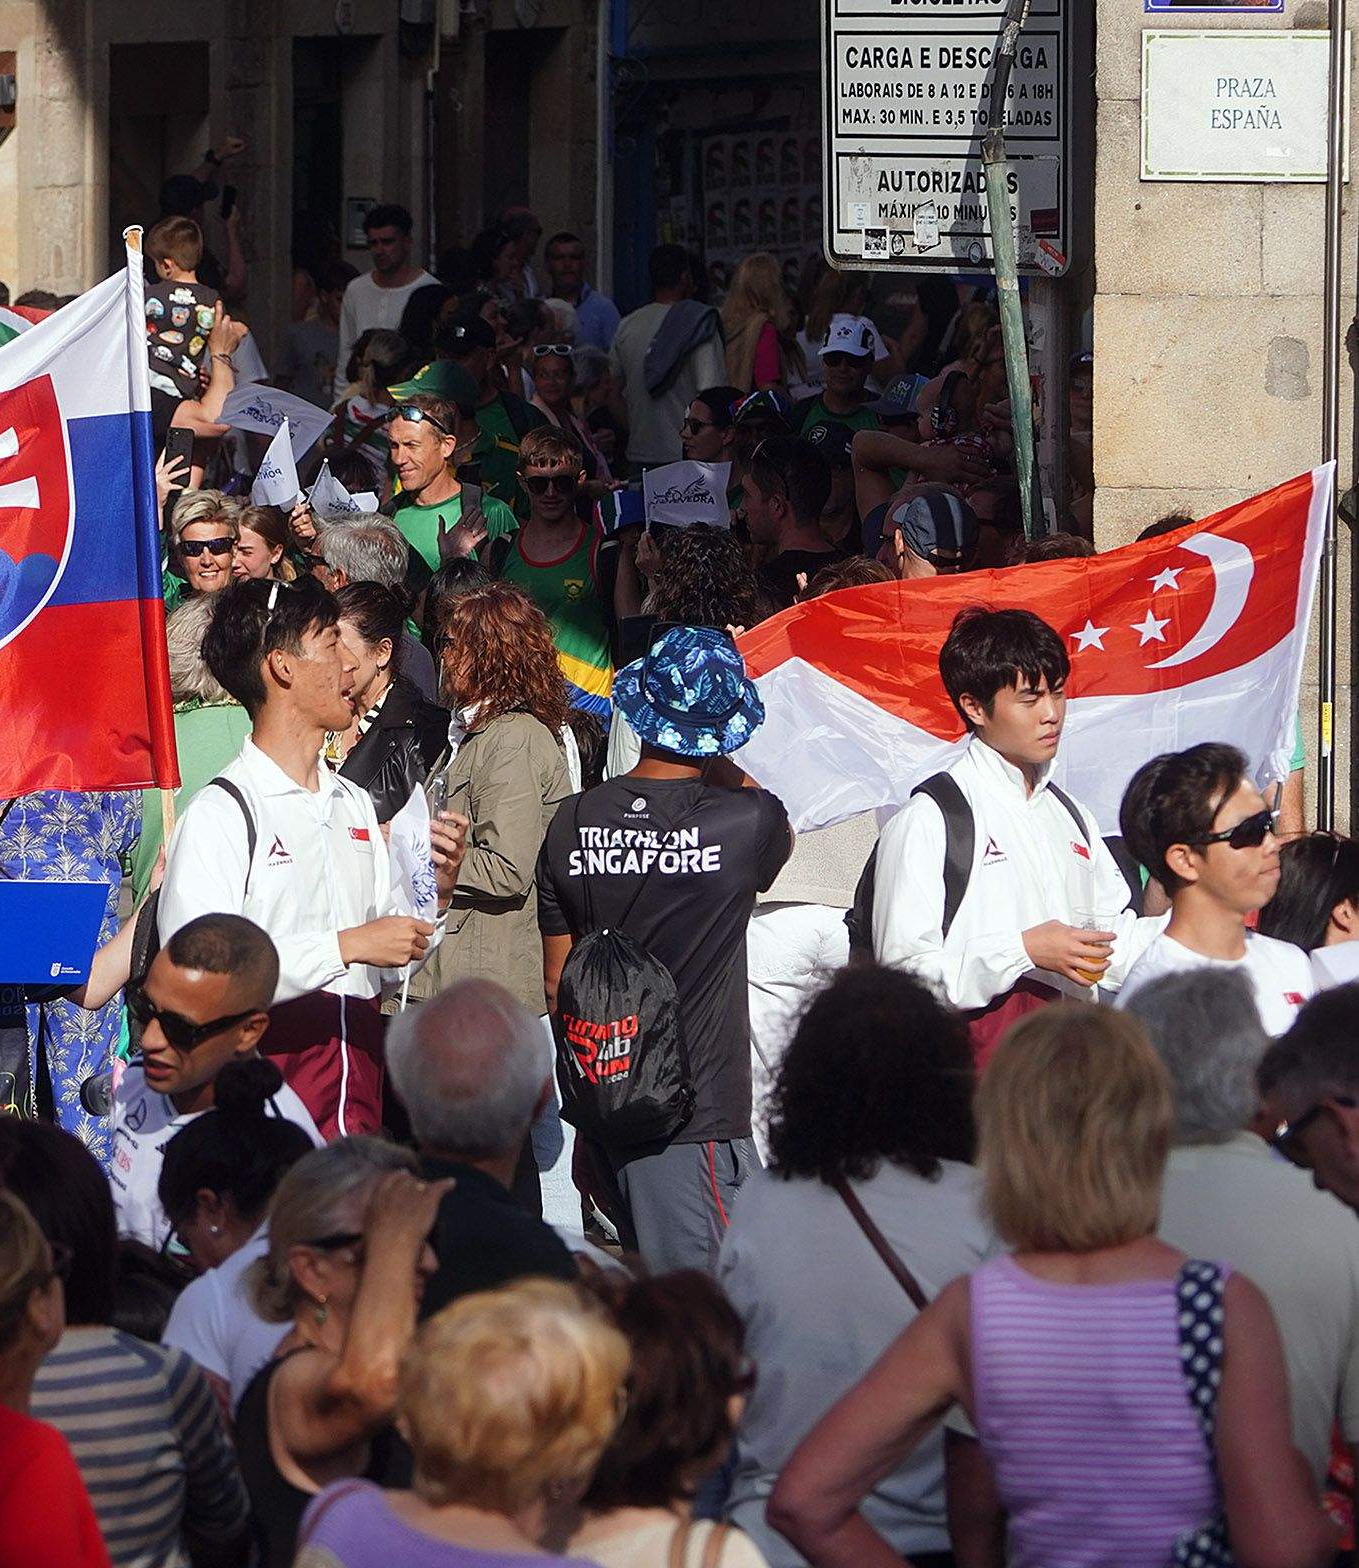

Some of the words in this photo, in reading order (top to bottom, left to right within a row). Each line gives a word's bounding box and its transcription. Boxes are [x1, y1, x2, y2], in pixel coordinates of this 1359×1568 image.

[845, 46, 914, 69] CARGA
[920, 47, 932, 69] E
[841, 82, 903, 98] LABORAIS
[907, 83, 924, 98] DE
[928, 83, 936, 99] 8
[940, 83, 949, 99] A
[953, 84, 965, 99] 12
[969, 84, 977, 99] E
[981, 84, 993, 99] D
[1019, 84, 1028, 98] A
[1032, 84, 1054, 99] 18H
[1215, 77, 1277, 98] PRAZA
[842, 108, 876, 125] MAX:
[880, 109, 895, 124] 30
[933, 110, 940, 125] E
[945, 110, 965, 129] 3,5
[970, 110, 1052, 126] TOELADAS
[1210, 104, 1283, 129] ESPAÑA
[877, 171, 1018, 193] AUTORIZADS
[878, 200, 917, 219] MÁXI
[936, 204, 949, 220] 10
[953, 203, 1017, 221] MINUS
[579, 826, 699, 850] TRIATHLON
[568, 844, 722, 876] SINGAPORE
